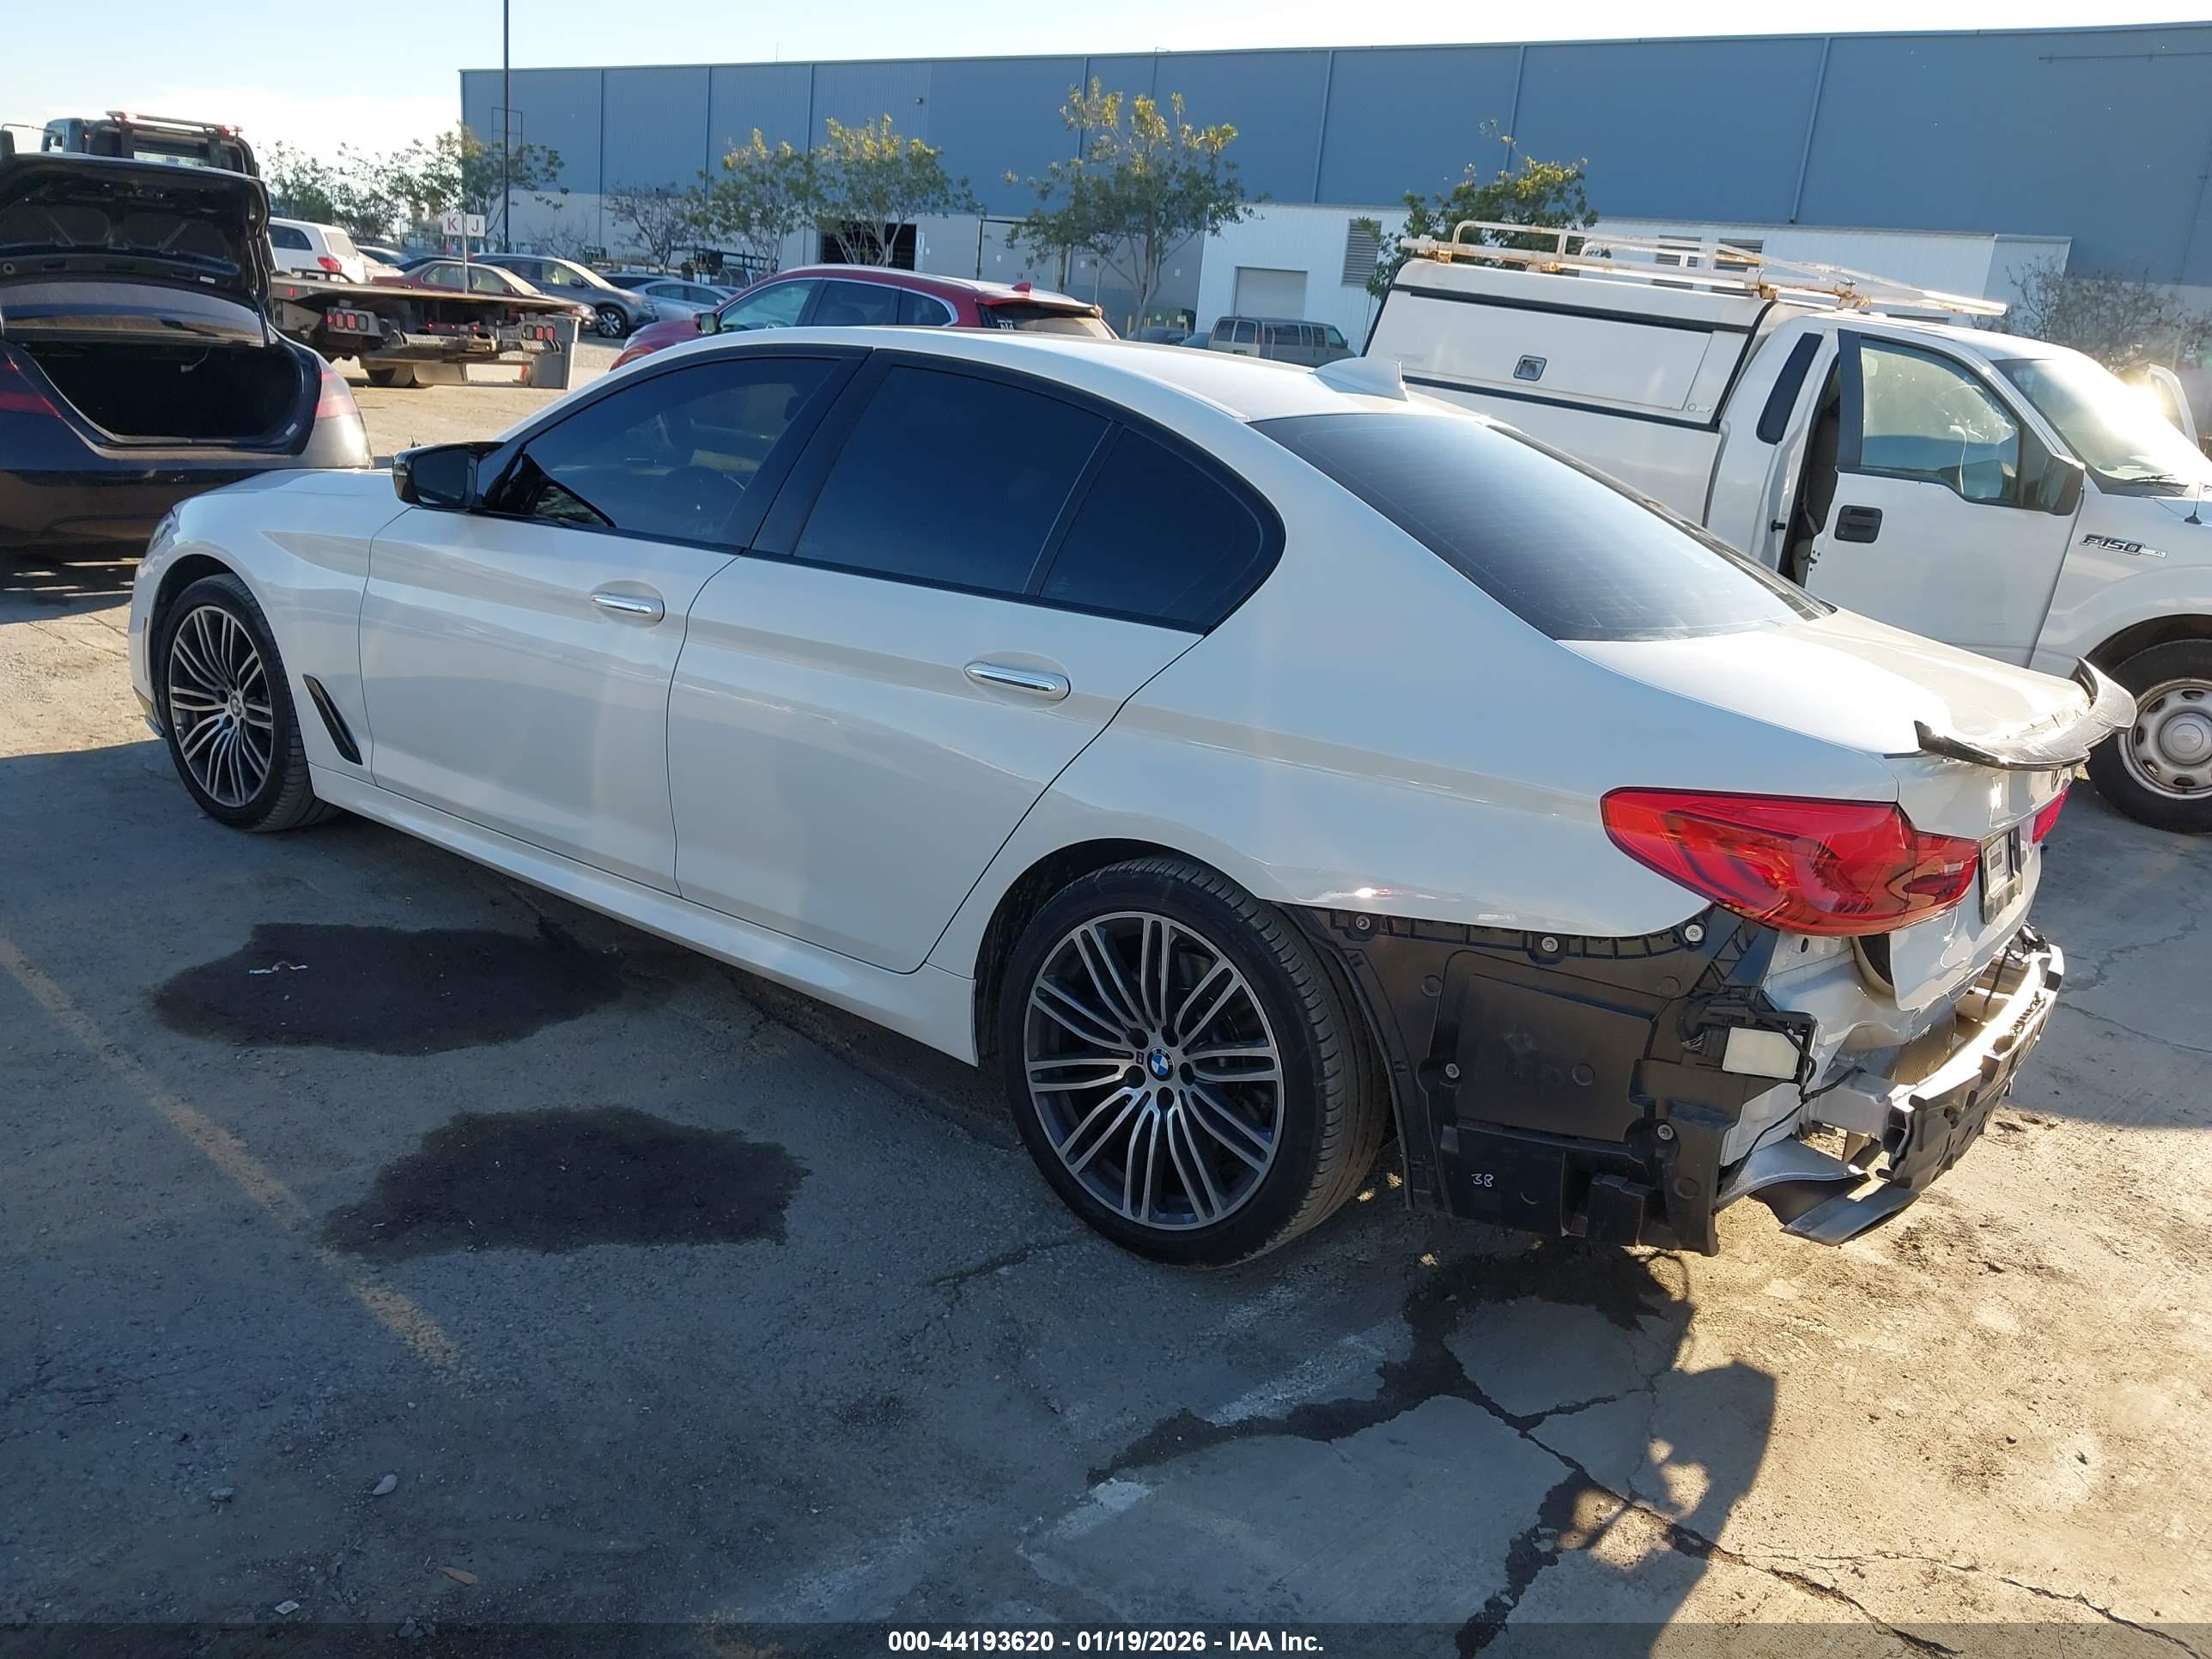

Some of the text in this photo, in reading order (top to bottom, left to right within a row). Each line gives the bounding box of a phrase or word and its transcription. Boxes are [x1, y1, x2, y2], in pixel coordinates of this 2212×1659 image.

[447, 217, 458, 231] K
[471, 219, 479, 233] J
[2081, 534, 2144, 555] F-150
[1471, 1173, 1494, 1188] 38
